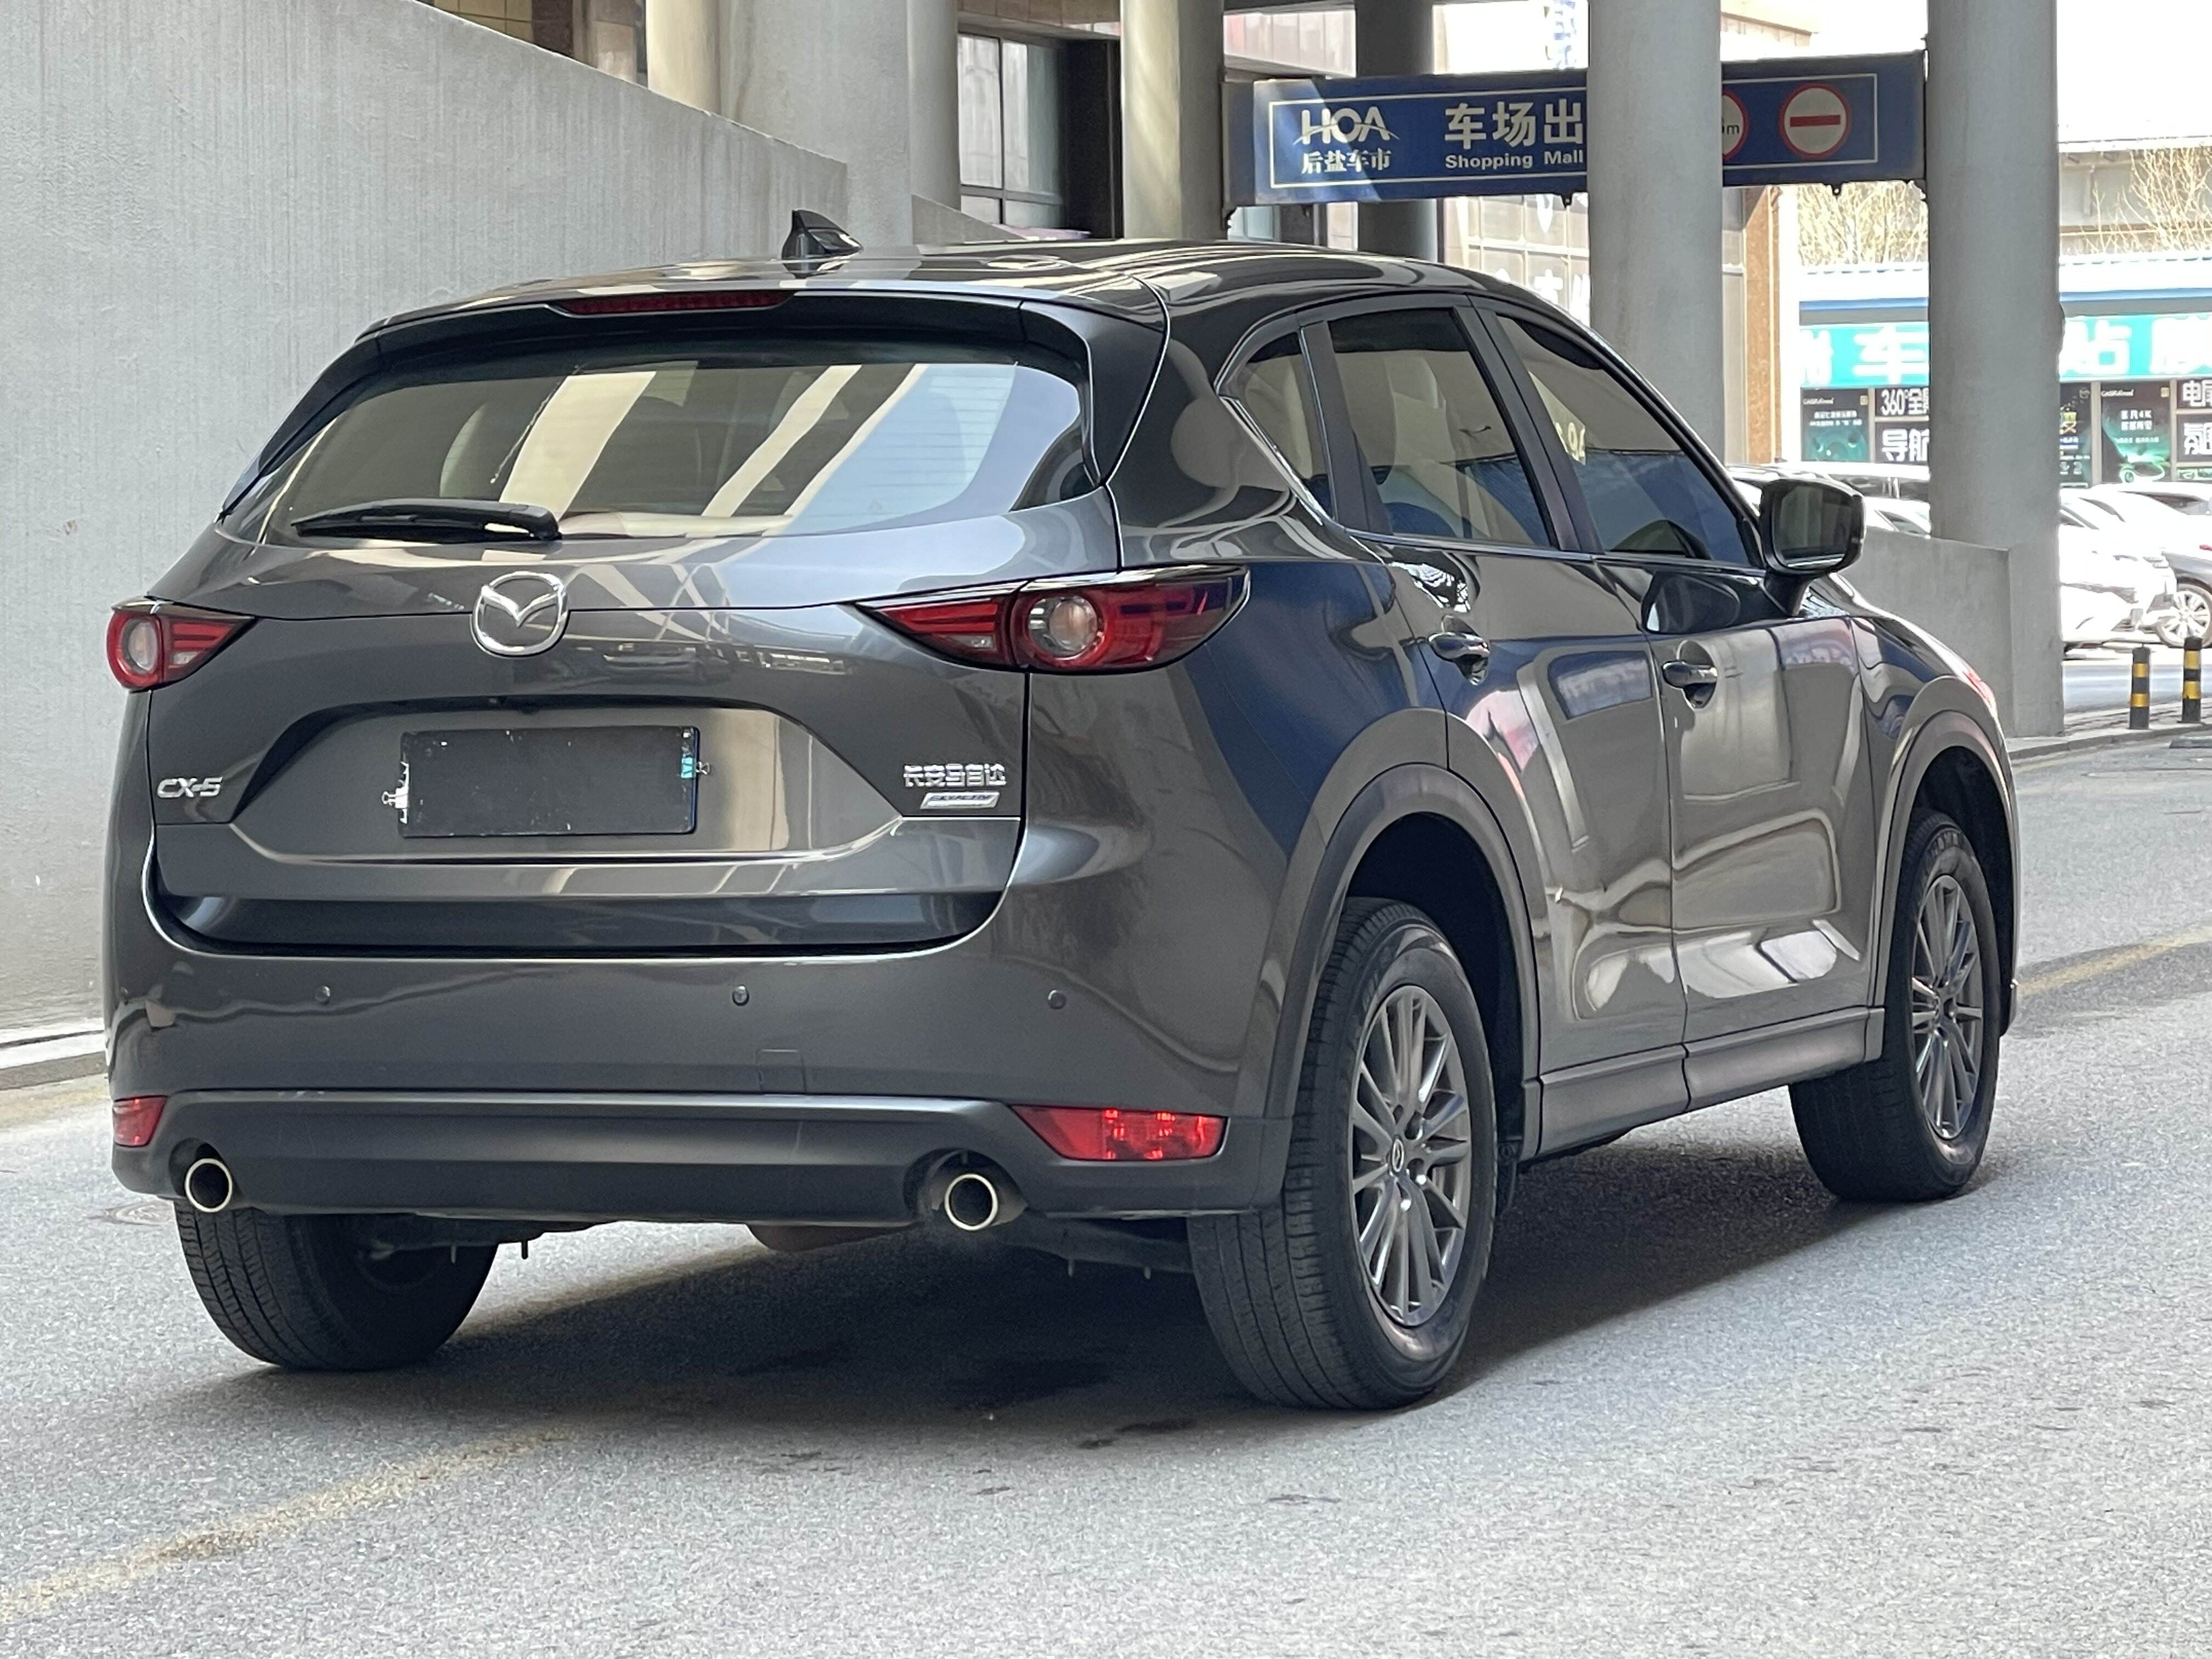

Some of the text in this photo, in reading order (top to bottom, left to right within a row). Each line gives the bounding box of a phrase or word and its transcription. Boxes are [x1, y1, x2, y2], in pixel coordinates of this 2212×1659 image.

[1301, 106, 1391, 144] HOA
[1301, 147, 1392, 174] 后盐车市
[1445, 149, 1583, 170] Shopping Mall
[157, 776, 223, 798] CX-5
